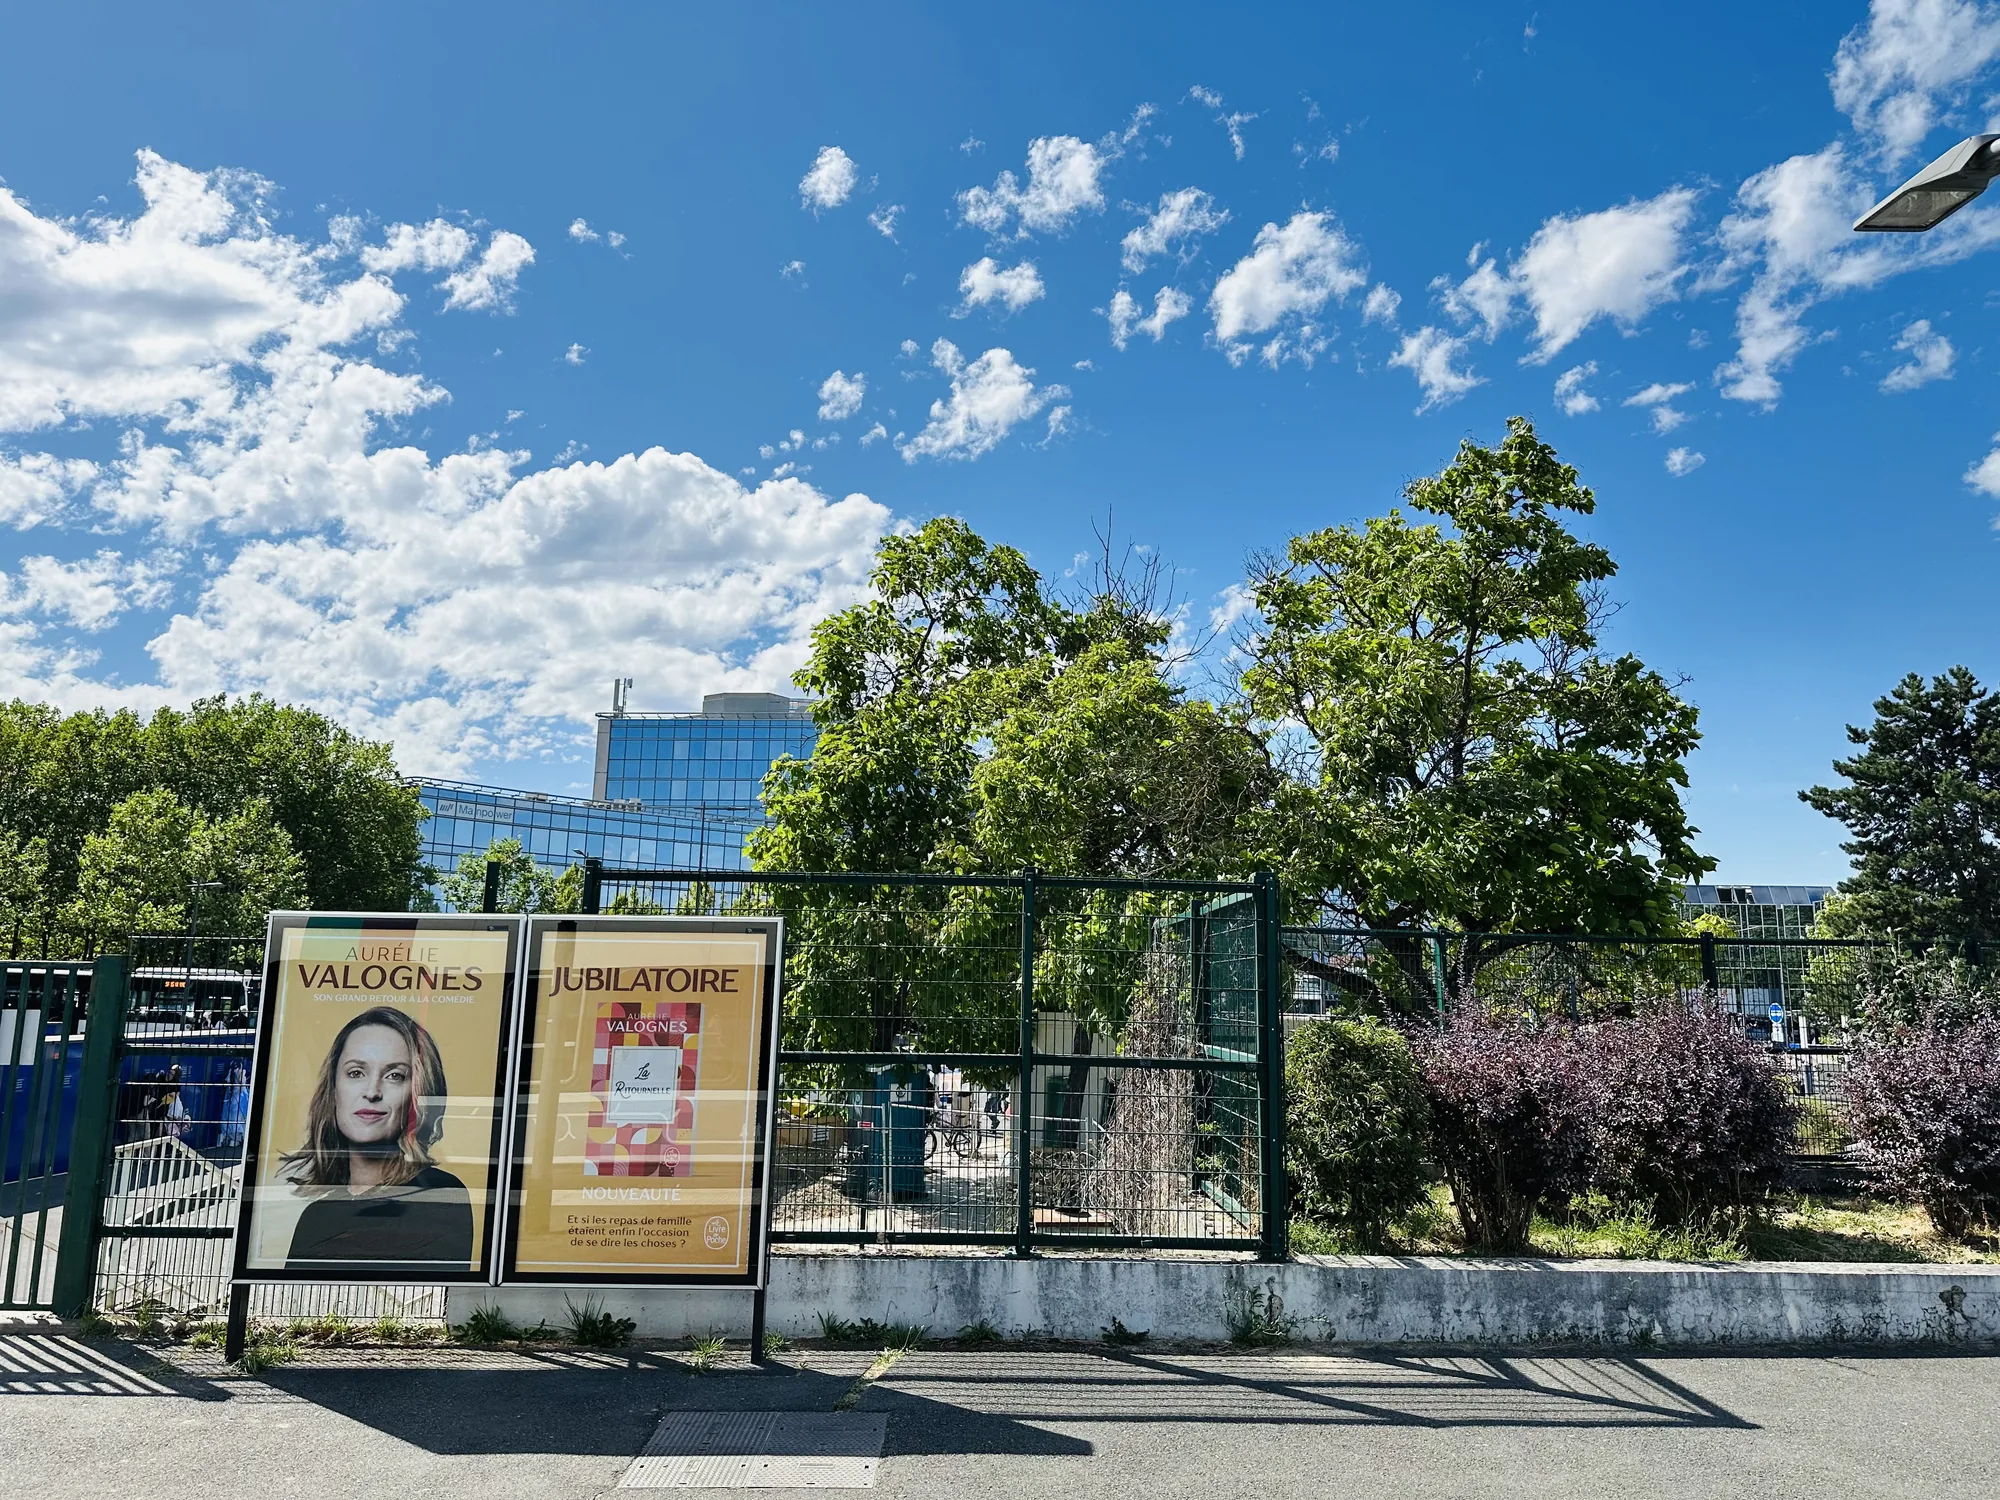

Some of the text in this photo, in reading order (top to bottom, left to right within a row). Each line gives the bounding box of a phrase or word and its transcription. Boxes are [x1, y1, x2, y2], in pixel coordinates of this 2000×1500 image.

[458, 804, 513, 819] Manpower
[345, 942, 439, 961] AURÉLIE
[298, 964, 483, 991] VALOGNES
[549, 966, 739, 997] JUBILATOIRE
[313, 993, 475, 1004] SON GRAND RETOUR À LA COMÉDIE
[627, 1012, 668, 1020] AURÉLIE
[606, 1020, 688, 1033] VALOGNES
[634, 1062, 651, 1080] La
[582, 1184, 682, 1202] NOUVEAUTÉ
[567, 1215, 692, 1228] Et si les repas de famille
[568, 1226, 689, 1237] étaient enfin l'occasion
[708, 1225, 726, 1233] Livre
[570, 1237, 686, 1248] de se dire les choses ?
[706, 1236, 727, 1244] Poche
